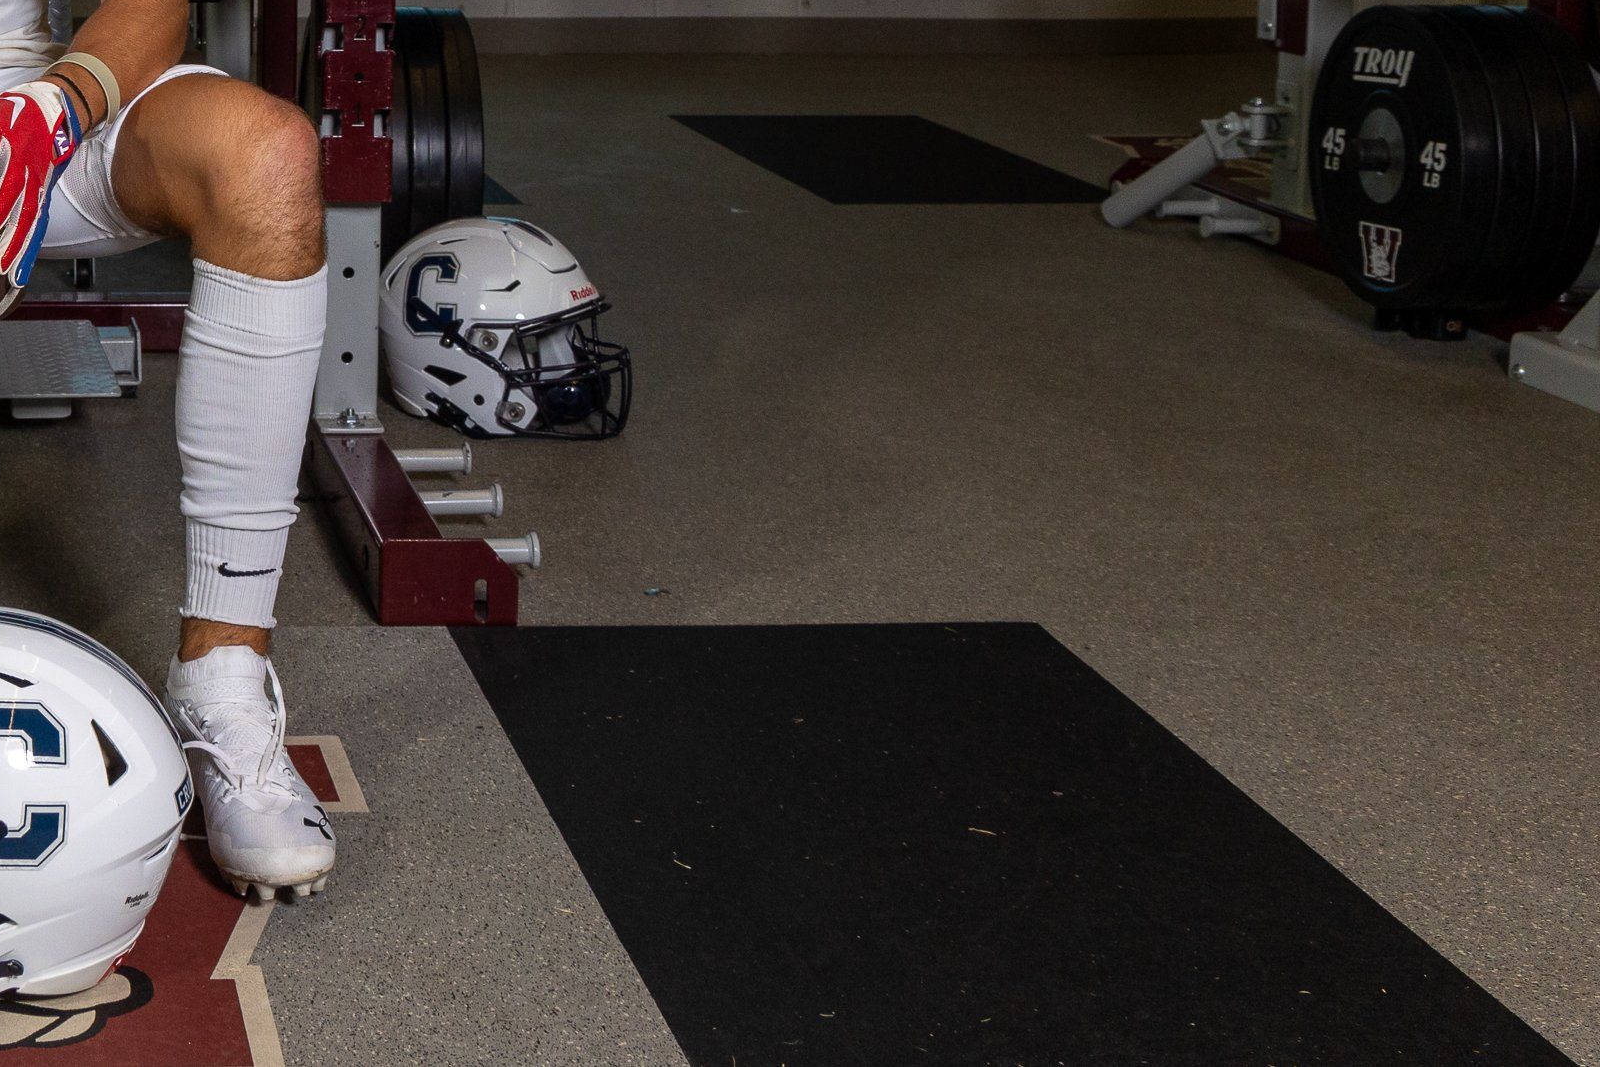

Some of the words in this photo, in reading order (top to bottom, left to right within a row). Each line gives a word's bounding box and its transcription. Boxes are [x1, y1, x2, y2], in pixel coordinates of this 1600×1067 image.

[353, 15, 366, 40] 2
[1352, 46, 1415, 88] TROY
[1321, 127, 1347, 156] 45
[1419, 140, 1448, 172] 45
[1324, 154, 1340, 171] LB
[1423, 171, 1441, 189] LB
[403, 251, 460, 336] C
